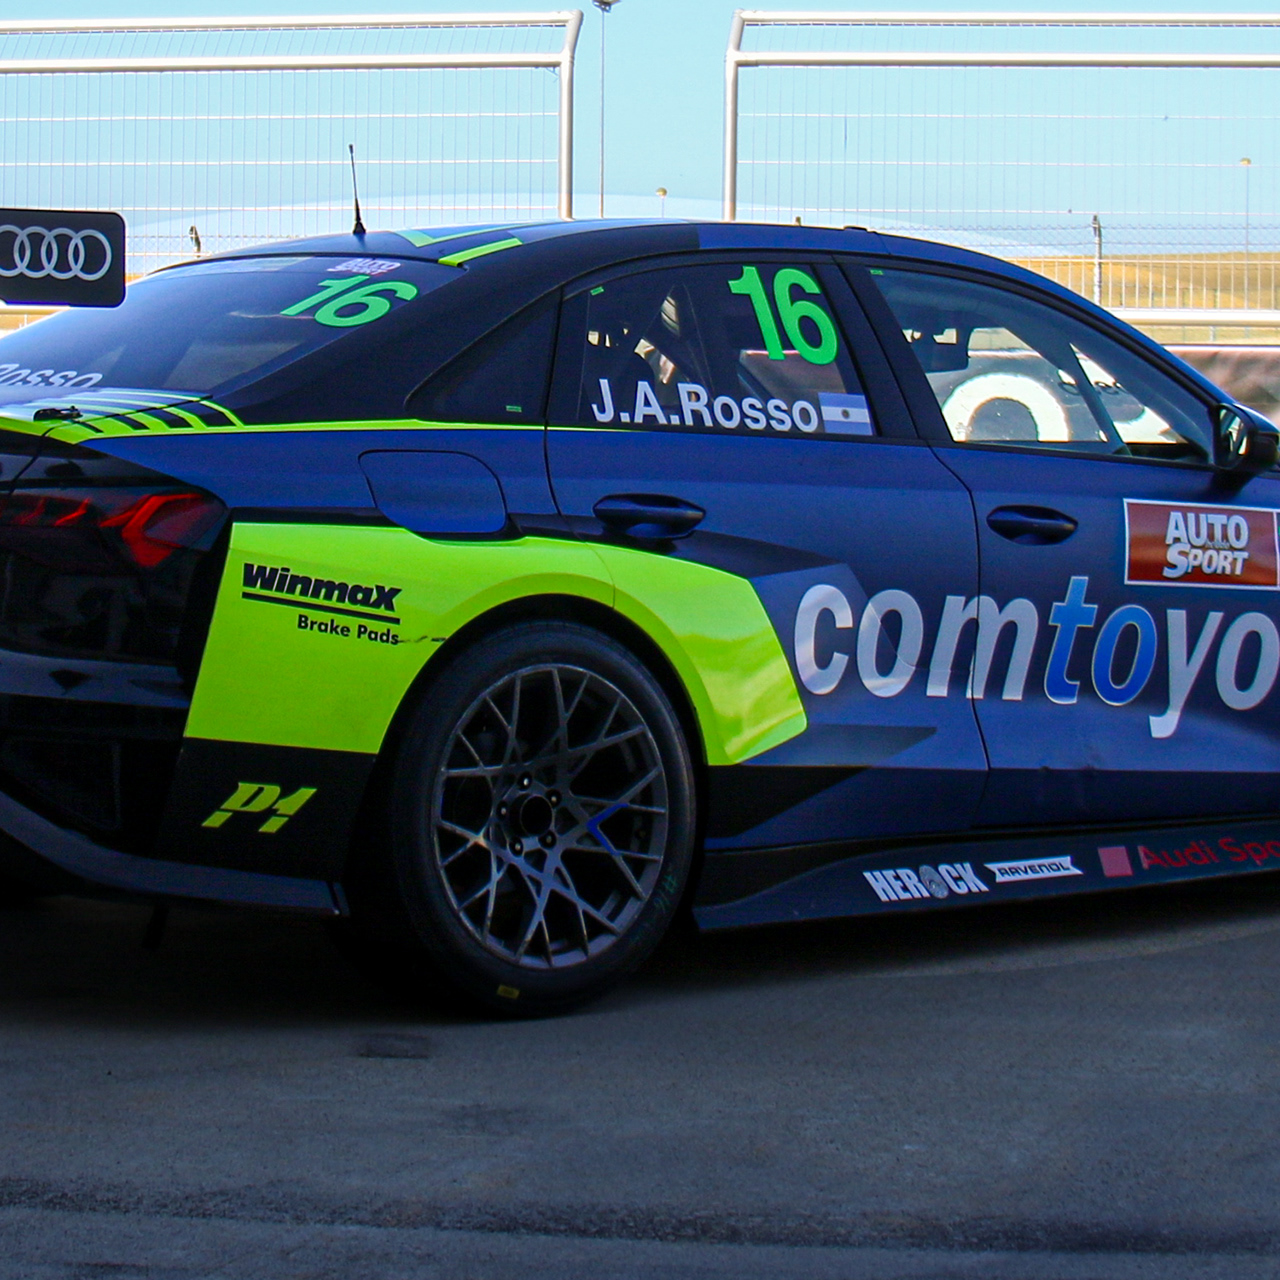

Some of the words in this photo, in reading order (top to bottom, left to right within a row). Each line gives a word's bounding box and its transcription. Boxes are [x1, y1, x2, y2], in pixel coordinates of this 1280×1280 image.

[279, 274, 418, 327] 16
[728, 266, 838, 365] 16
[1165, 511, 1249, 549] AUTO
[1162, 542, 1250, 578] SPORT
[297, 614, 351, 637] Brake
[357, 624, 399, 645] Pads
[1138, 840, 1219, 869] Audi
